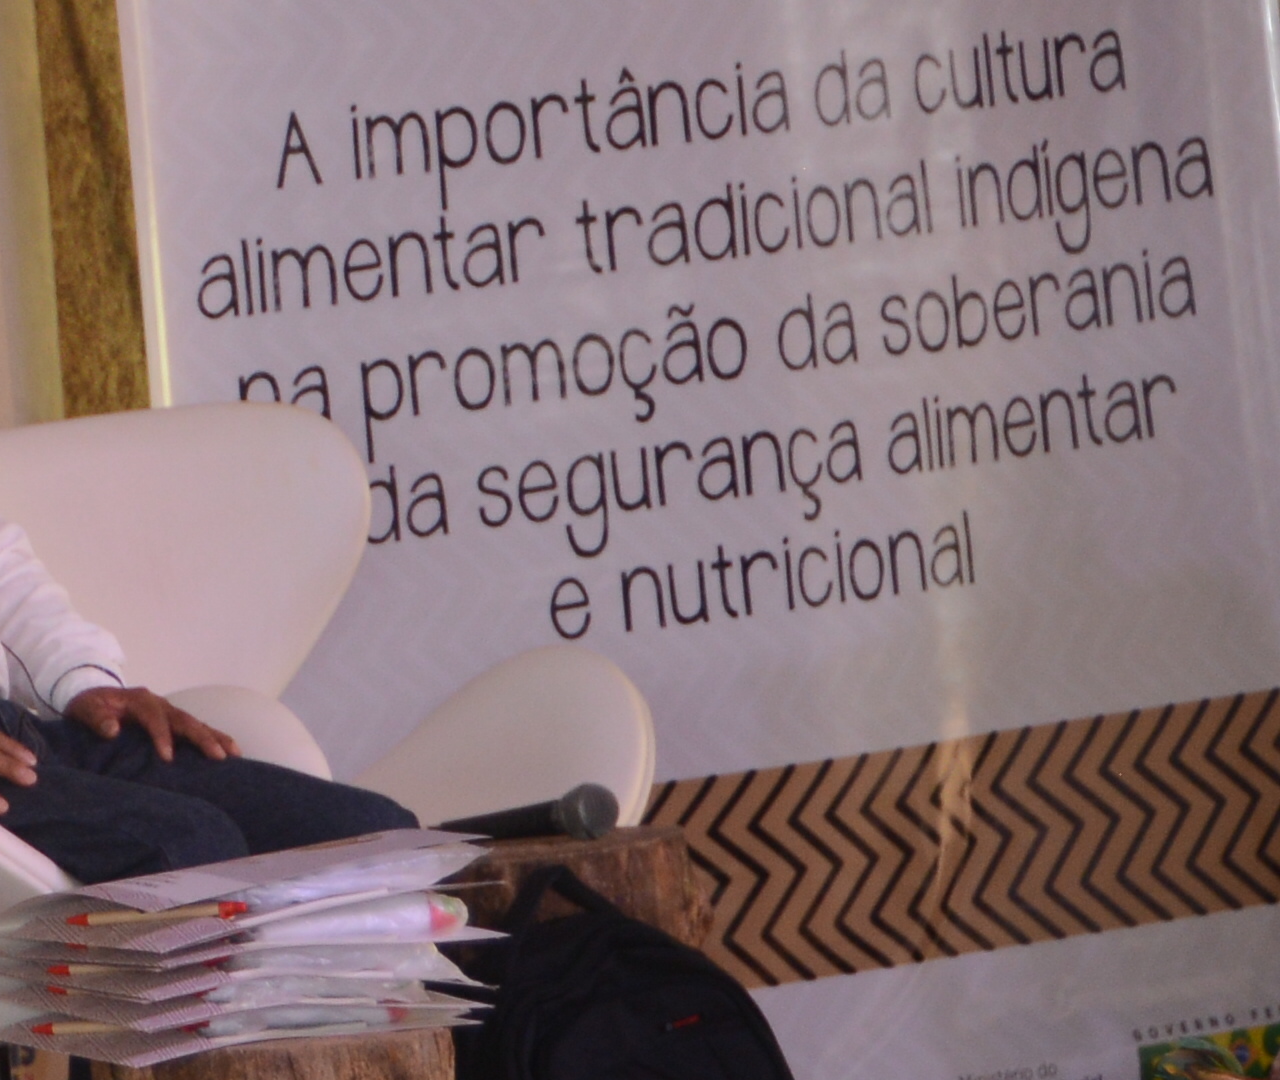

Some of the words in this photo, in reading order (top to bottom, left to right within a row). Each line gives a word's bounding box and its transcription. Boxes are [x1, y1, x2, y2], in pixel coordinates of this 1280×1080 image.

[276, 110, 323, 190] A
[349, 62, 791, 211] importância
[813, 49, 892, 127] da
[914, 29, 1127, 115] cultura
[196, 215, 546, 320] alimentar
[574, 158, 934, 277] tradicional
[954, 137, 1215, 255] indígena
[360, 302, 748, 464] promoção
[777, 293, 859, 371] da
[880, 249, 1198, 357] soberania
[366, 465, 449, 545] da
[476, 419, 863, 558] segurança
[887, 373, 1177, 476] alimentar
[549, 576, 592, 640] e
[620, 510, 976, 633] nutricional
